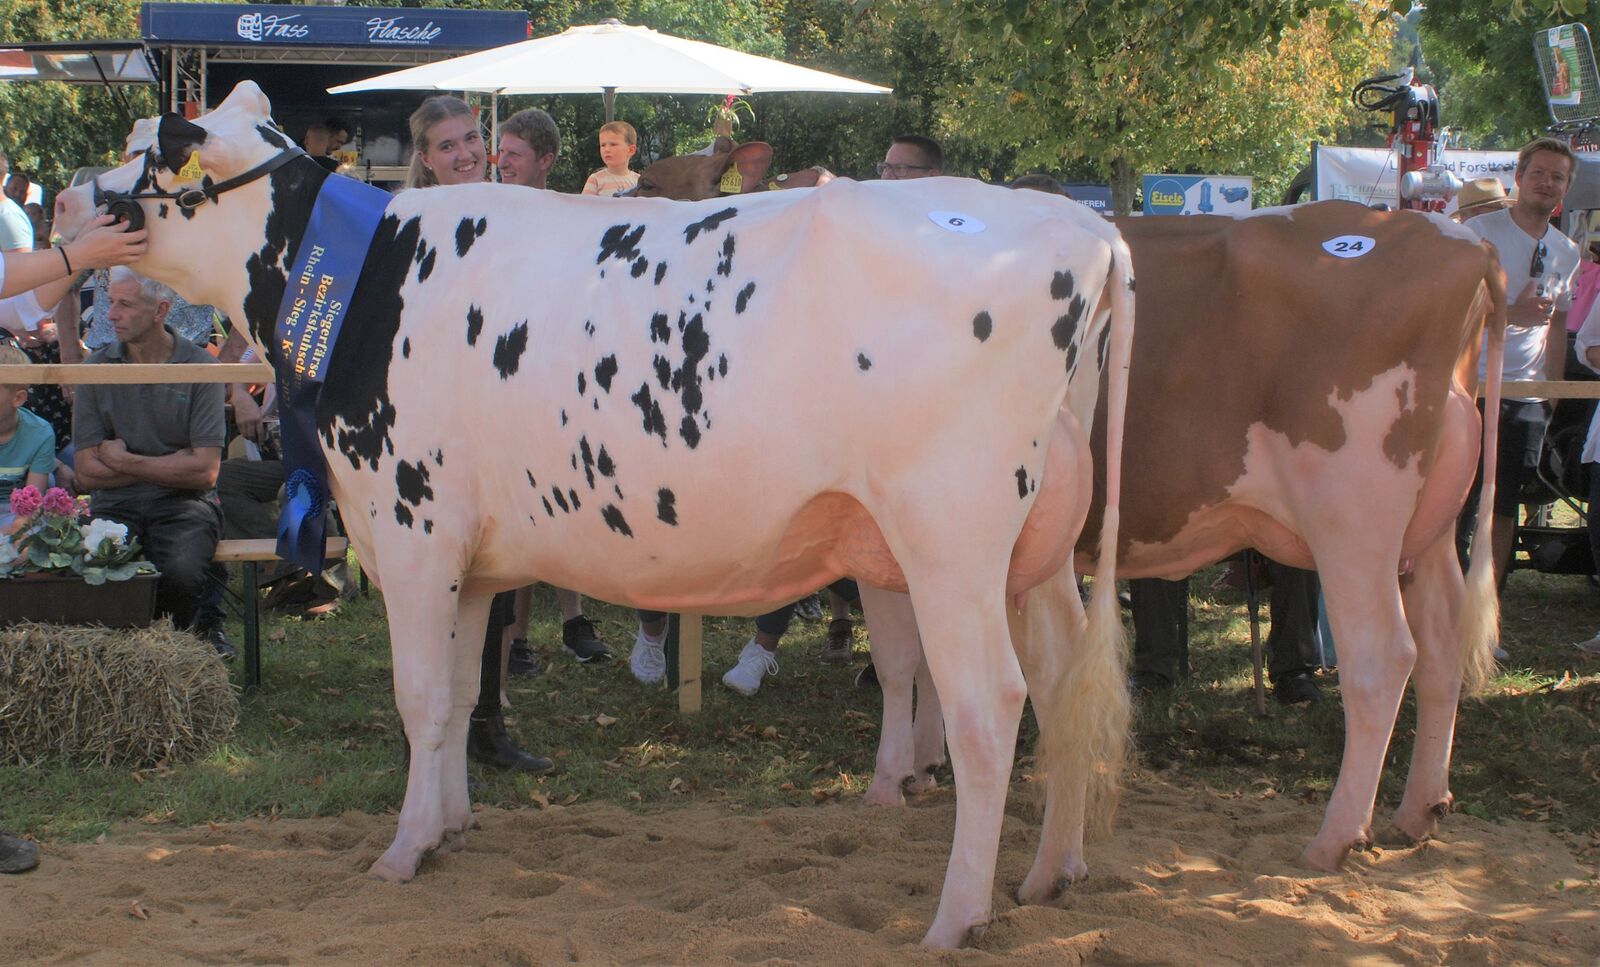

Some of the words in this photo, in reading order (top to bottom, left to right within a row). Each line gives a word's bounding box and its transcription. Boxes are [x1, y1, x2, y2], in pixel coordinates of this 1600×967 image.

[263, 14, 309, 38] Fass
[366, 16, 441, 40] Flasche
[1151, 191, 1185, 203] Eisele
[948, 217, 966, 226] 6
[1334, 241, 1364, 252] 24
[300, 244, 326, 285] Rhein
[285, 297, 307, 328] Sieg
[308, 300, 342, 378] Siegerfärse
